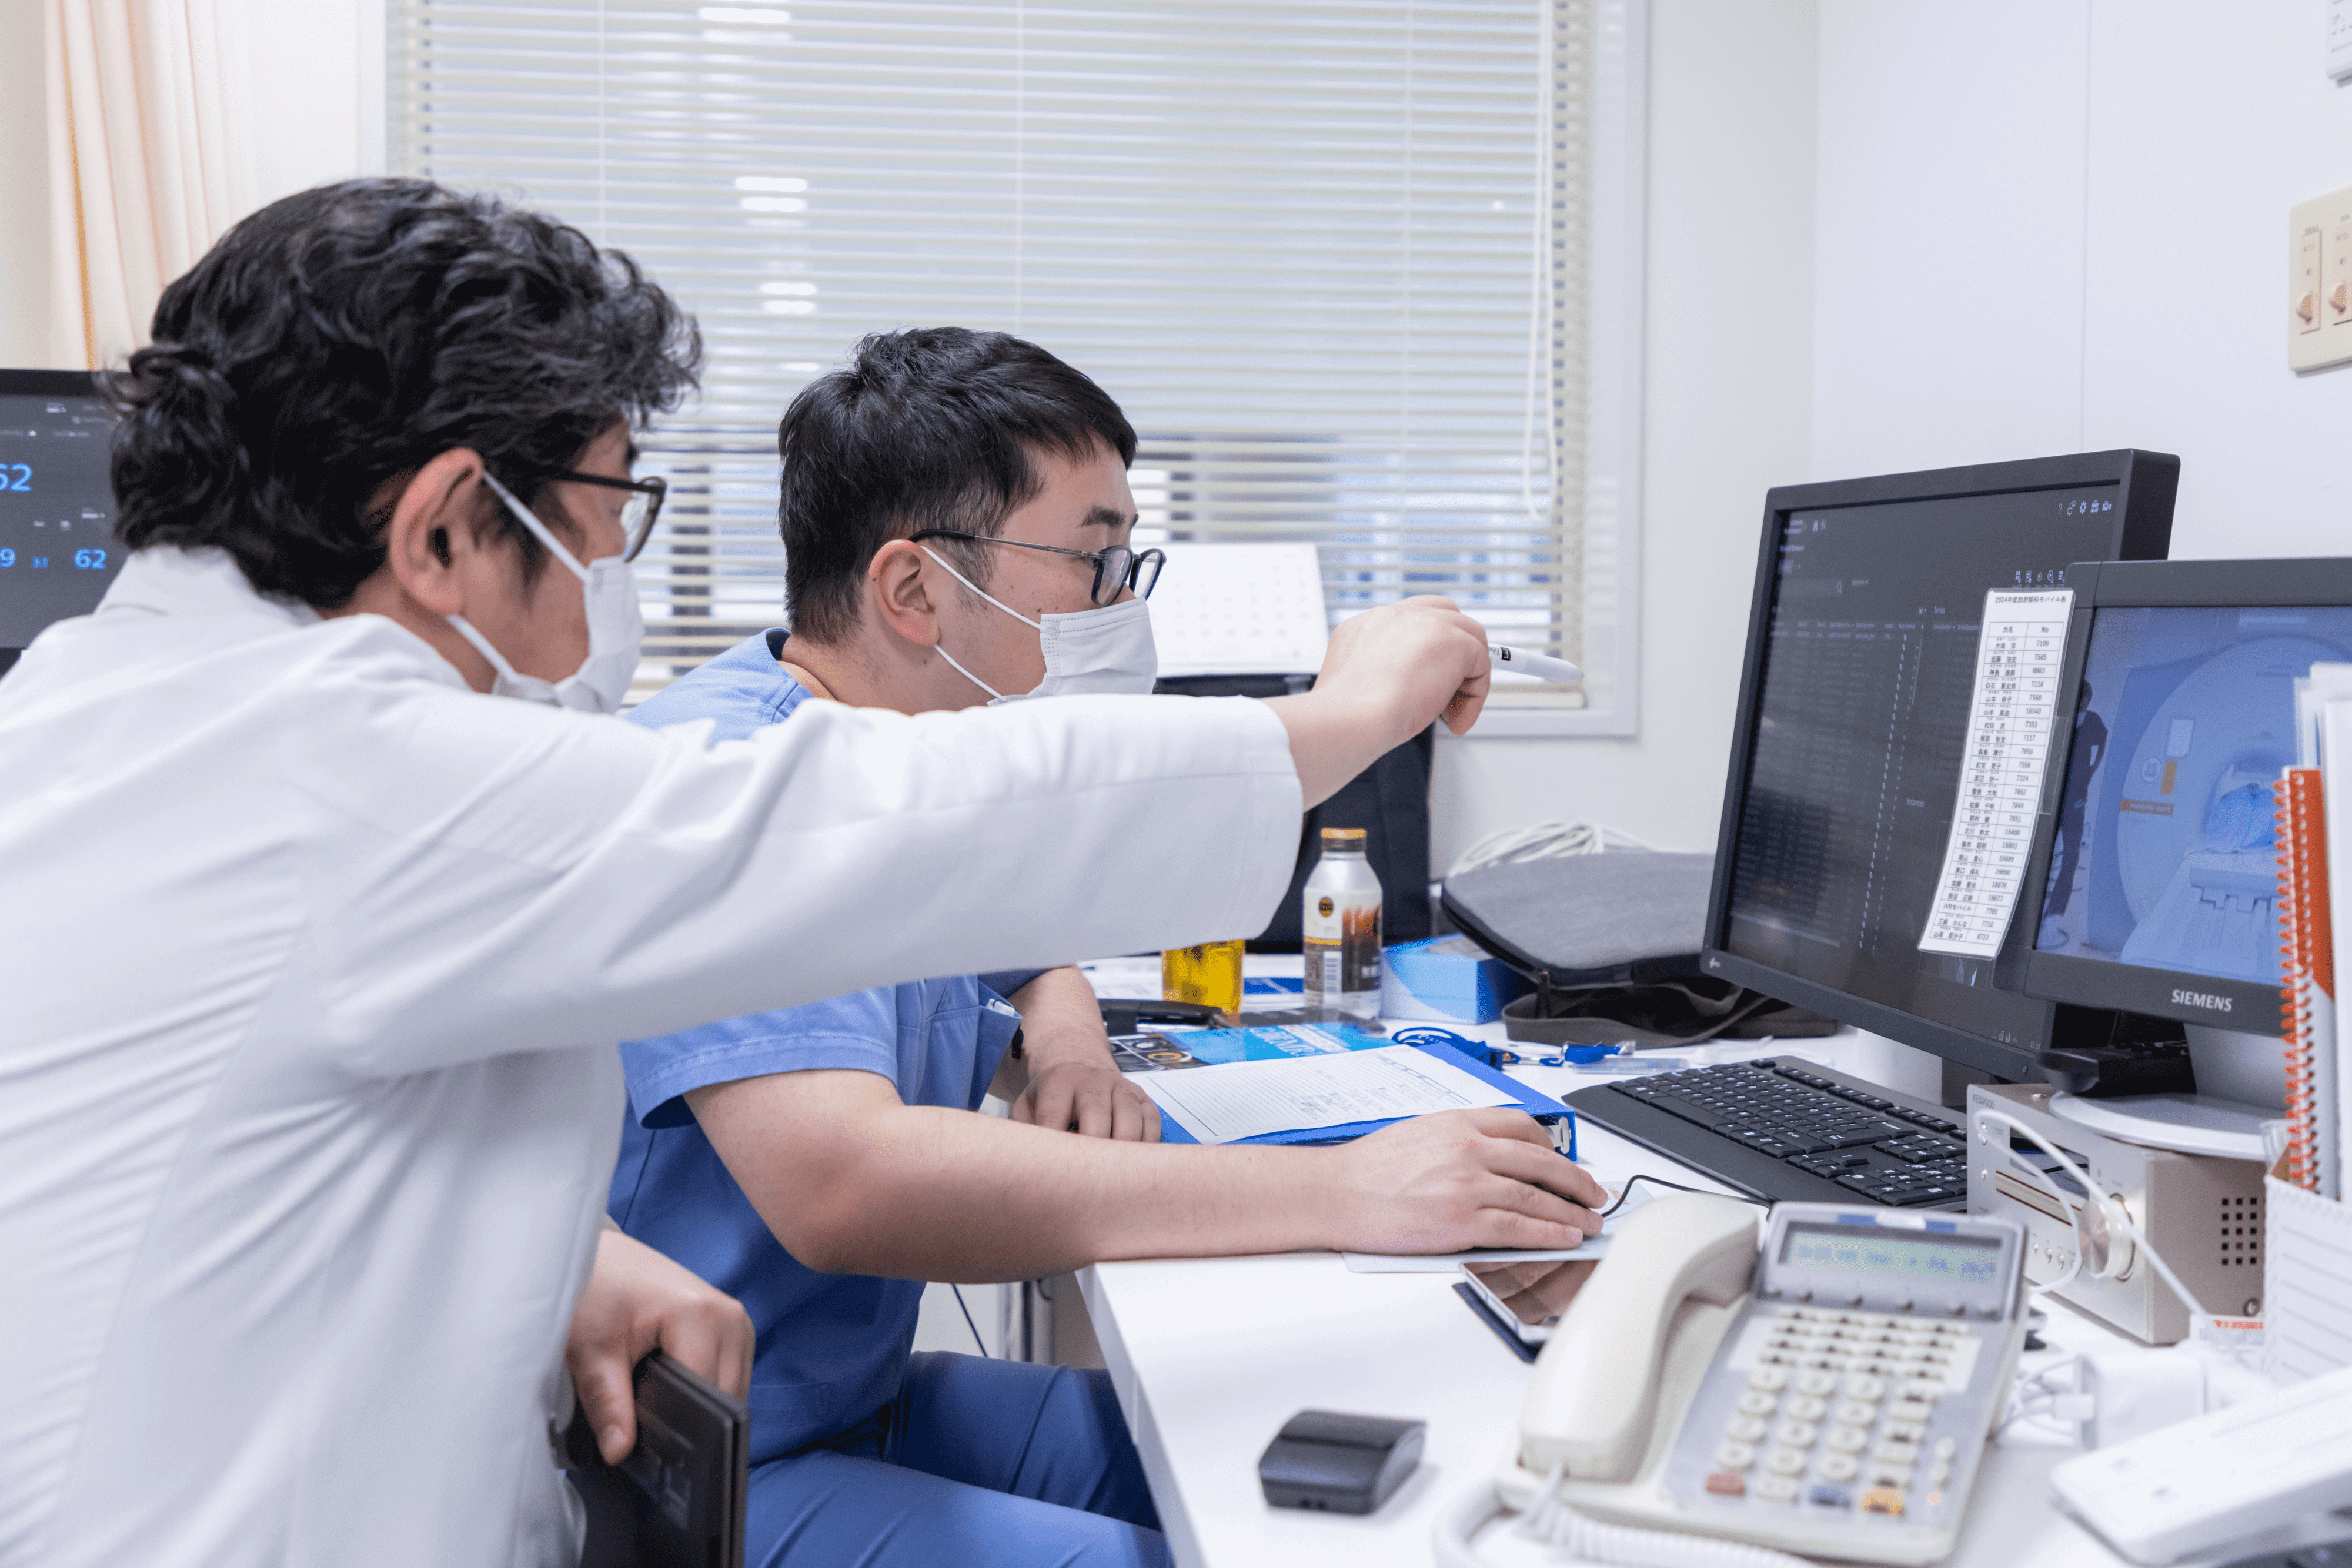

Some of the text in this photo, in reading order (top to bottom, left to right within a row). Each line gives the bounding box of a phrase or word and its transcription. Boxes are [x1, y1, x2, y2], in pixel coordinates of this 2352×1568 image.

[74, 548, 106, 569] 62
[1943, 903, 1972, 911] IVRモバイル
[2172, 989, 2233, 1011] SIEMENS
[1973, 1094, 1994, 1109] KENWOOD
